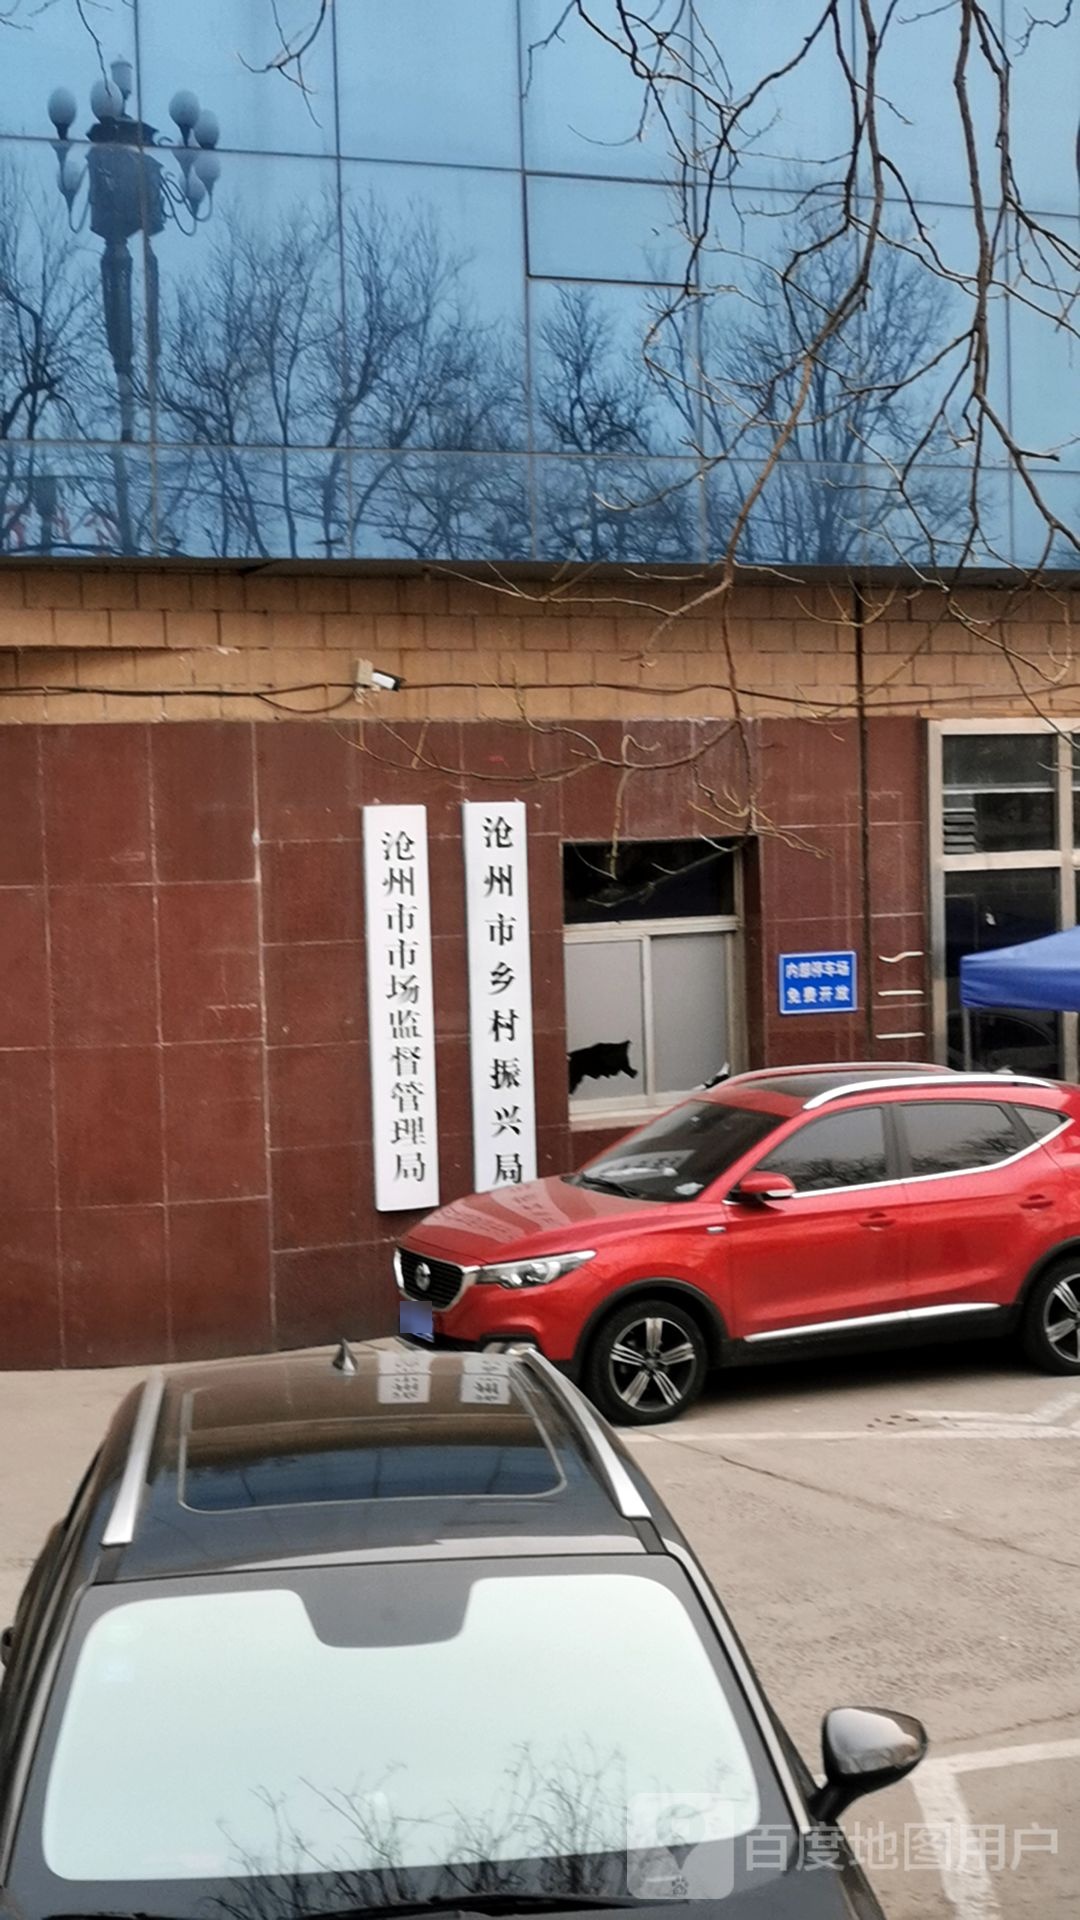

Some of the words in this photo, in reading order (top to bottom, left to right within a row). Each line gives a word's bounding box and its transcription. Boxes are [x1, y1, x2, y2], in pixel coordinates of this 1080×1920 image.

[381, 831, 426, 1183] 沧州市市场监督管理局
[482, 815, 523, 1185] 沧州市乡村振兴局
[785, 960, 850, 979] 内部停车场
[786, 984, 850, 1004] 免费开放
